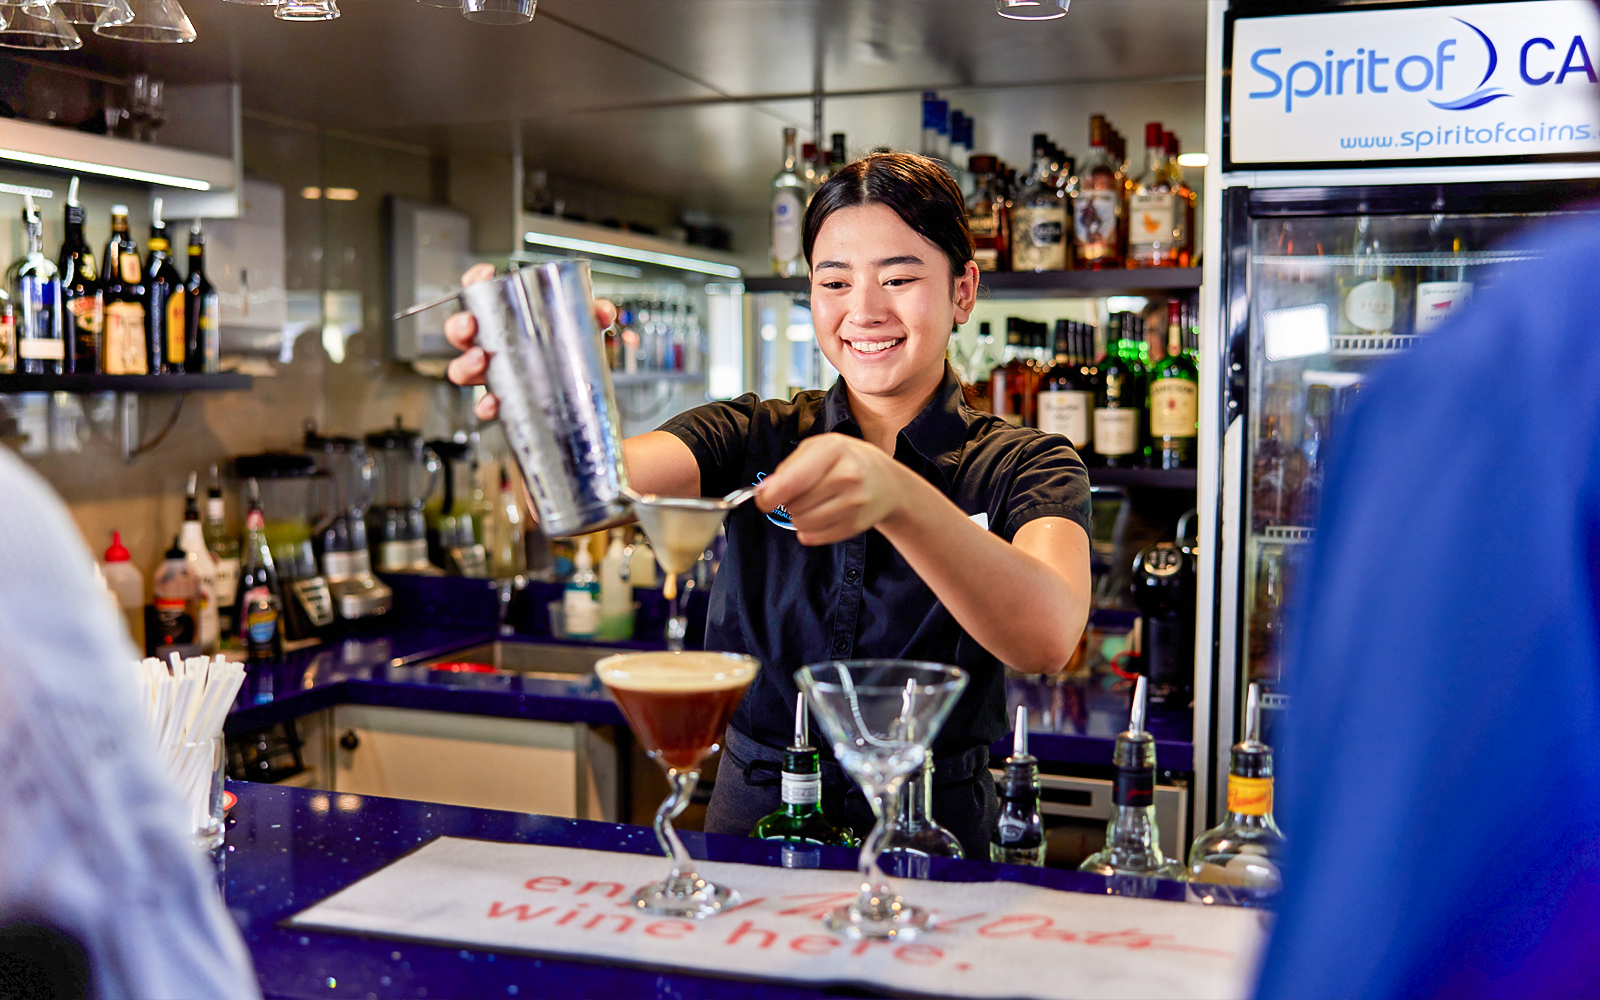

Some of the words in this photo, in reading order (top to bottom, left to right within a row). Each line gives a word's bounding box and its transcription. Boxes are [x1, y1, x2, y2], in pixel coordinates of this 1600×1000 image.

[1249, 48, 1389, 113] Spirit
[1395, 39, 1457, 93] of
[1340, 122, 1600, 151] www.spiritofcairns.
[487, 900, 696, 939] wine
[725, 920, 973, 971] here.
